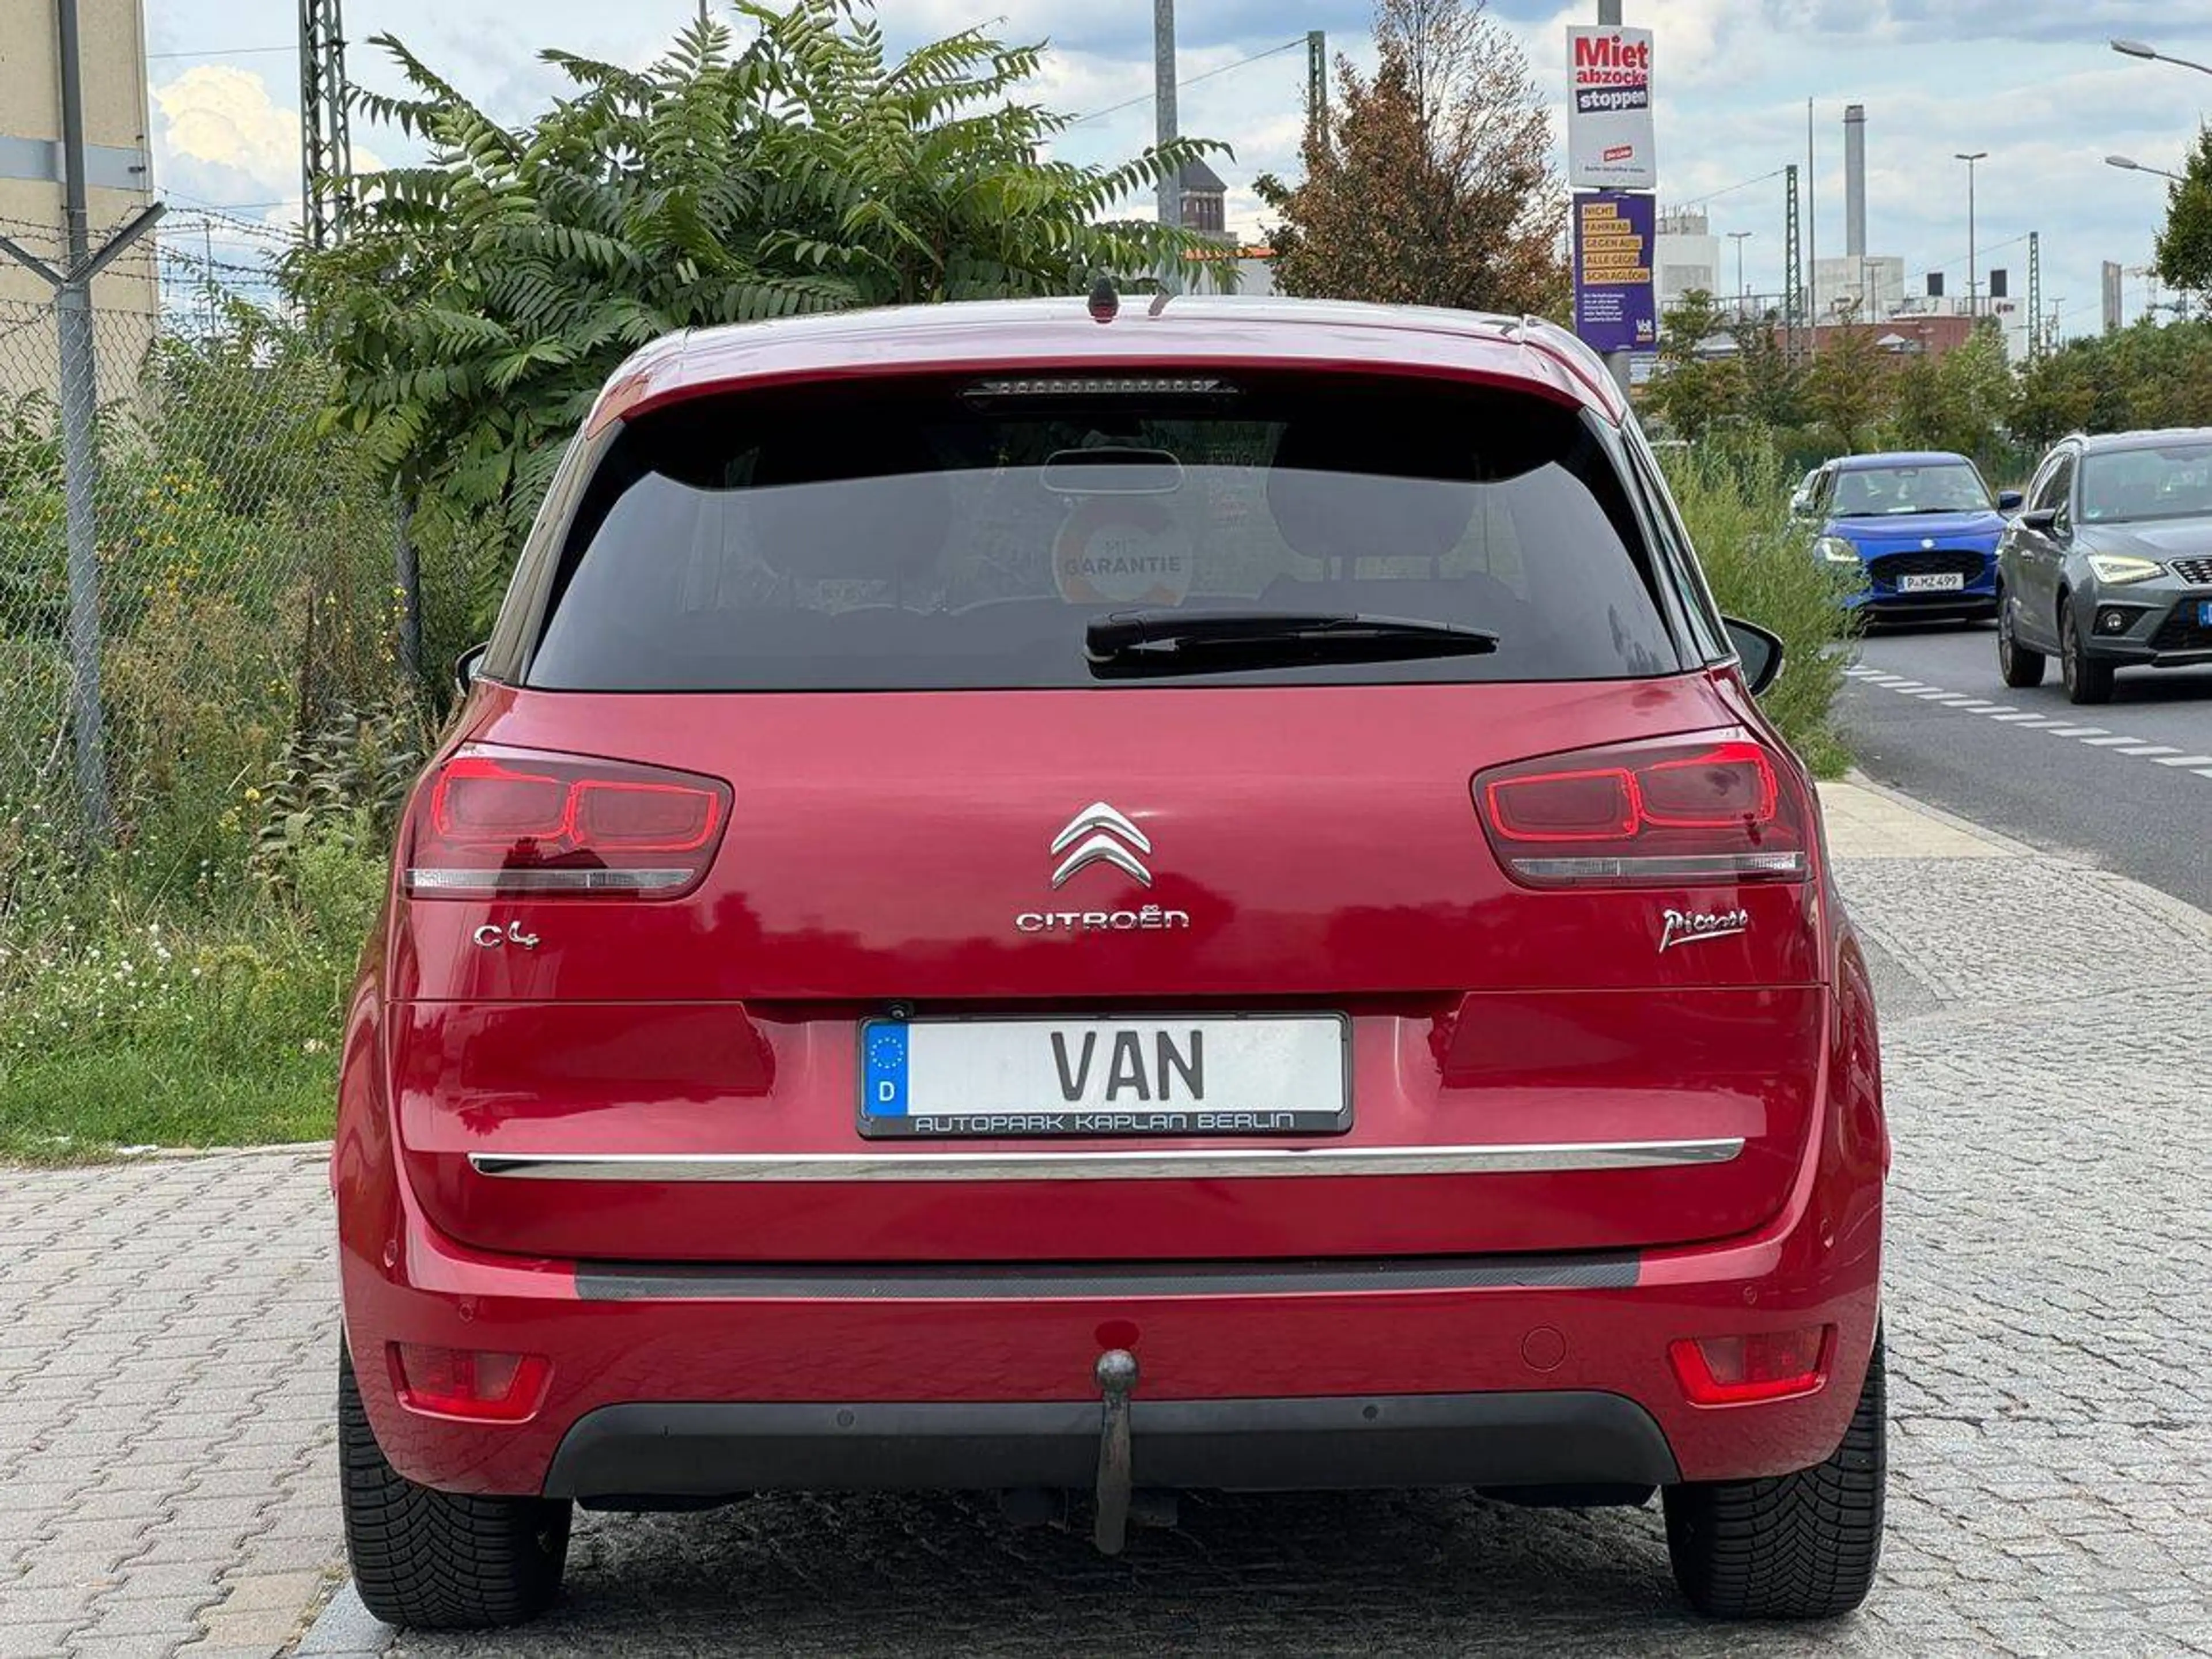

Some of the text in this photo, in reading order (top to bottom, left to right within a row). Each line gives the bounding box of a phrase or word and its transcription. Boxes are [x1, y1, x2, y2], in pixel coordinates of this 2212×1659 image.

[1575, 35, 1648, 69] Miet
[1577, 69, 1647, 84] abzocke
[1580, 90, 1646, 109] stoppen
[1584, 206, 1613, 215] NICHT
[1586, 254, 1609, 264] ALLE
[1065, 556, 1181, 576] GARANTIE
[1016, 904, 1190, 931] CITROËN
[474, 921, 540, 949] C4
[1050, 1030, 1204, 1101] VAN
[879, 1082, 895, 1101] D
[916, 1113, 1294, 1132] AUTOPARK KAPLAN BERLIN
